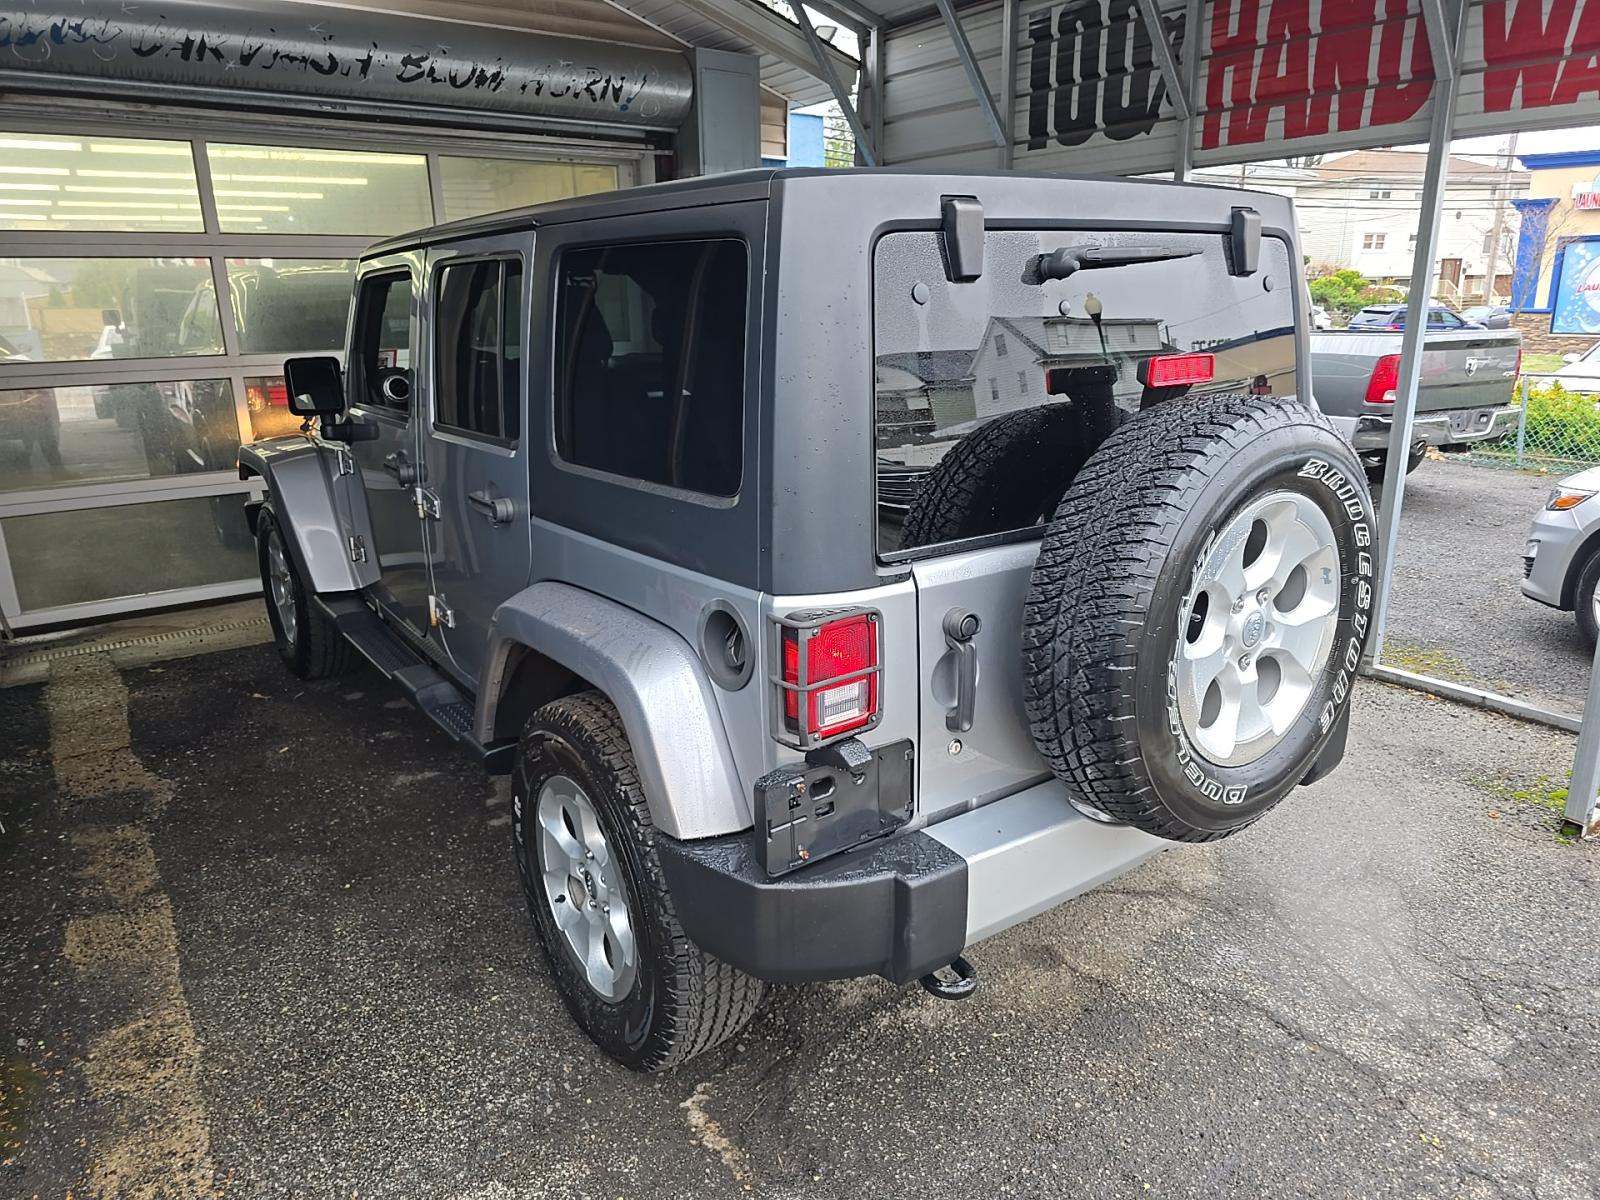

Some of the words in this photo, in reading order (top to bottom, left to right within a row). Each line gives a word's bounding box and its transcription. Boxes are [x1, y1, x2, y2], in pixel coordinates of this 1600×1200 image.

[1201, 0, 1435, 151] HAND
[1297, 458, 1372, 735] BRIDGESTONE
[1166, 660, 1248, 805] DUELER
